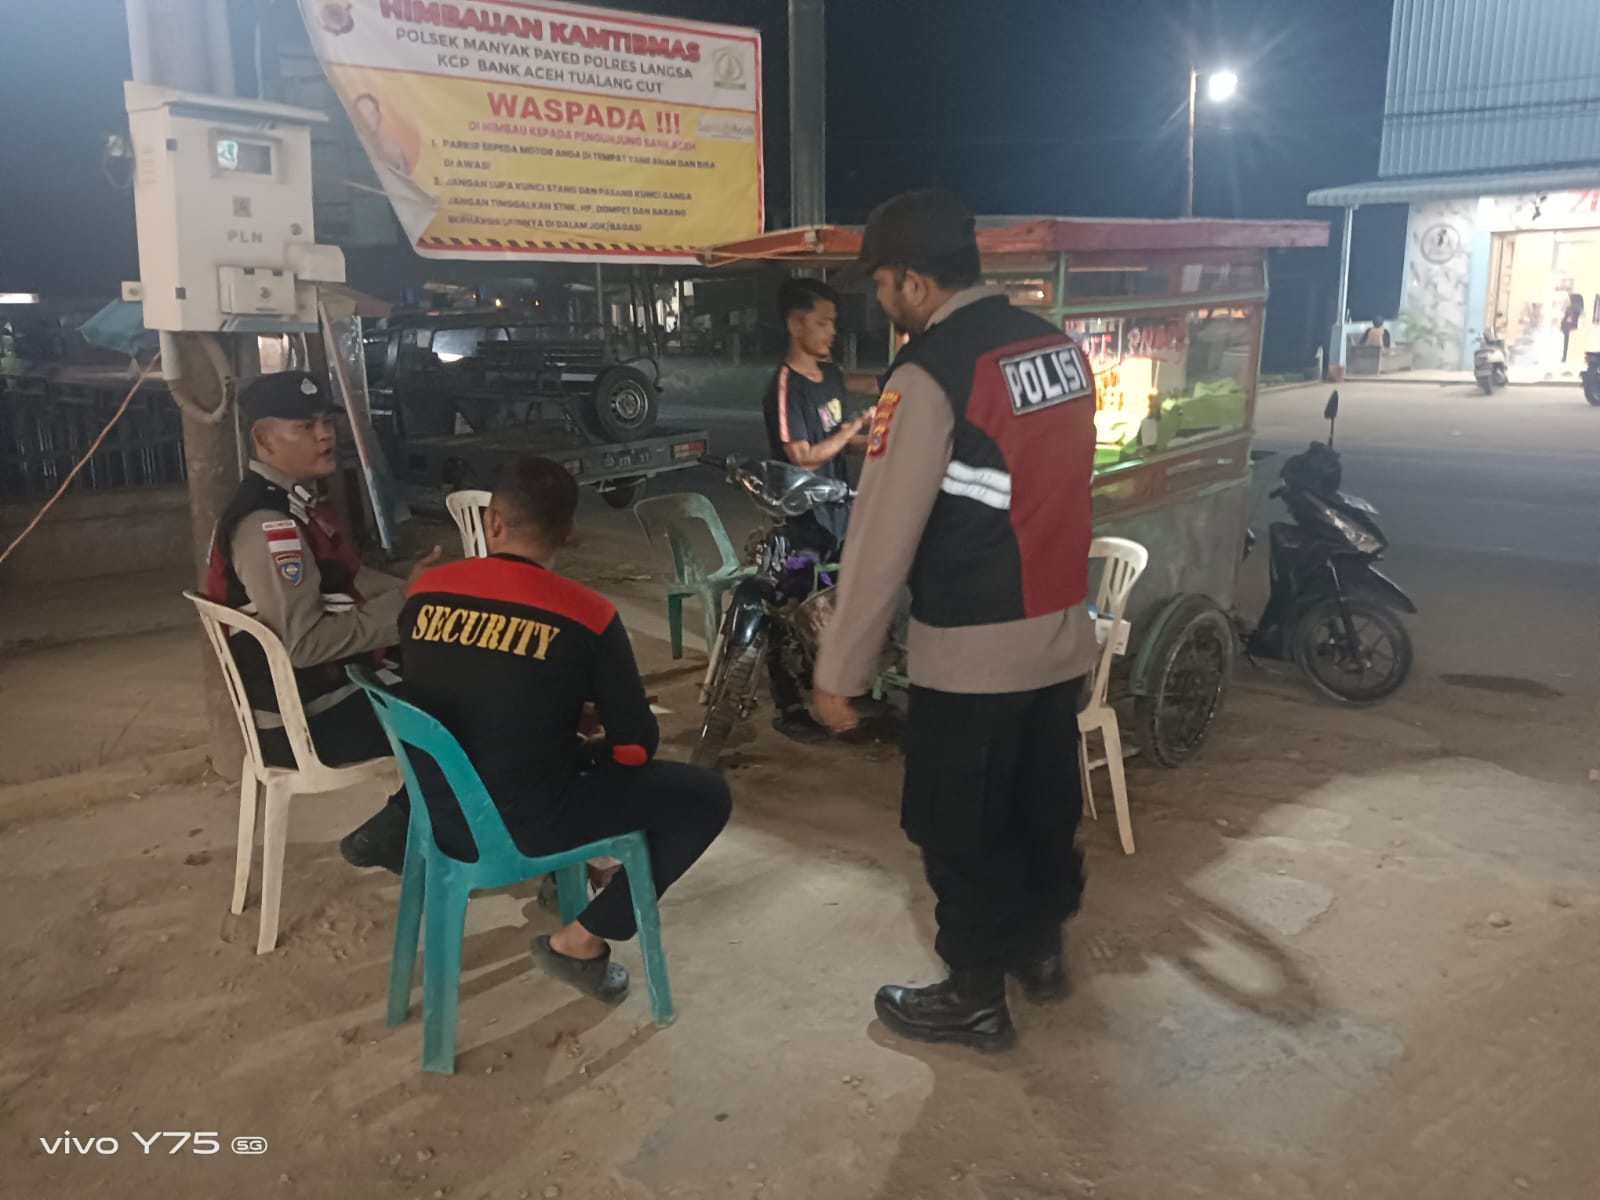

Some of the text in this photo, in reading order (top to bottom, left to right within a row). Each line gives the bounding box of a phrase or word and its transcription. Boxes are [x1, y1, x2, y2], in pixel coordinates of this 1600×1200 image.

[396, 27, 693, 79] POLSEK MANYAK PAYED POLRES LANGSA
[549, 21, 701, 63] KAMTIBMAS
[437, 54, 663, 94] KCP BANK ACEH TUALANG CUT
[468, 121, 480, 131] DI
[482, 122, 527, 136] HIMBAU
[529, 127, 572, 140] KEPADA
[574, 132, 642, 147] PENGUNJUNG
[487, 92, 646, 132] WASPADA
[656, 111, 681, 135] !!!
[227, 230, 263, 243] PLN
[1005, 348, 1087, 408] POLISI
[411, 604, 560, 660] SECURITY
